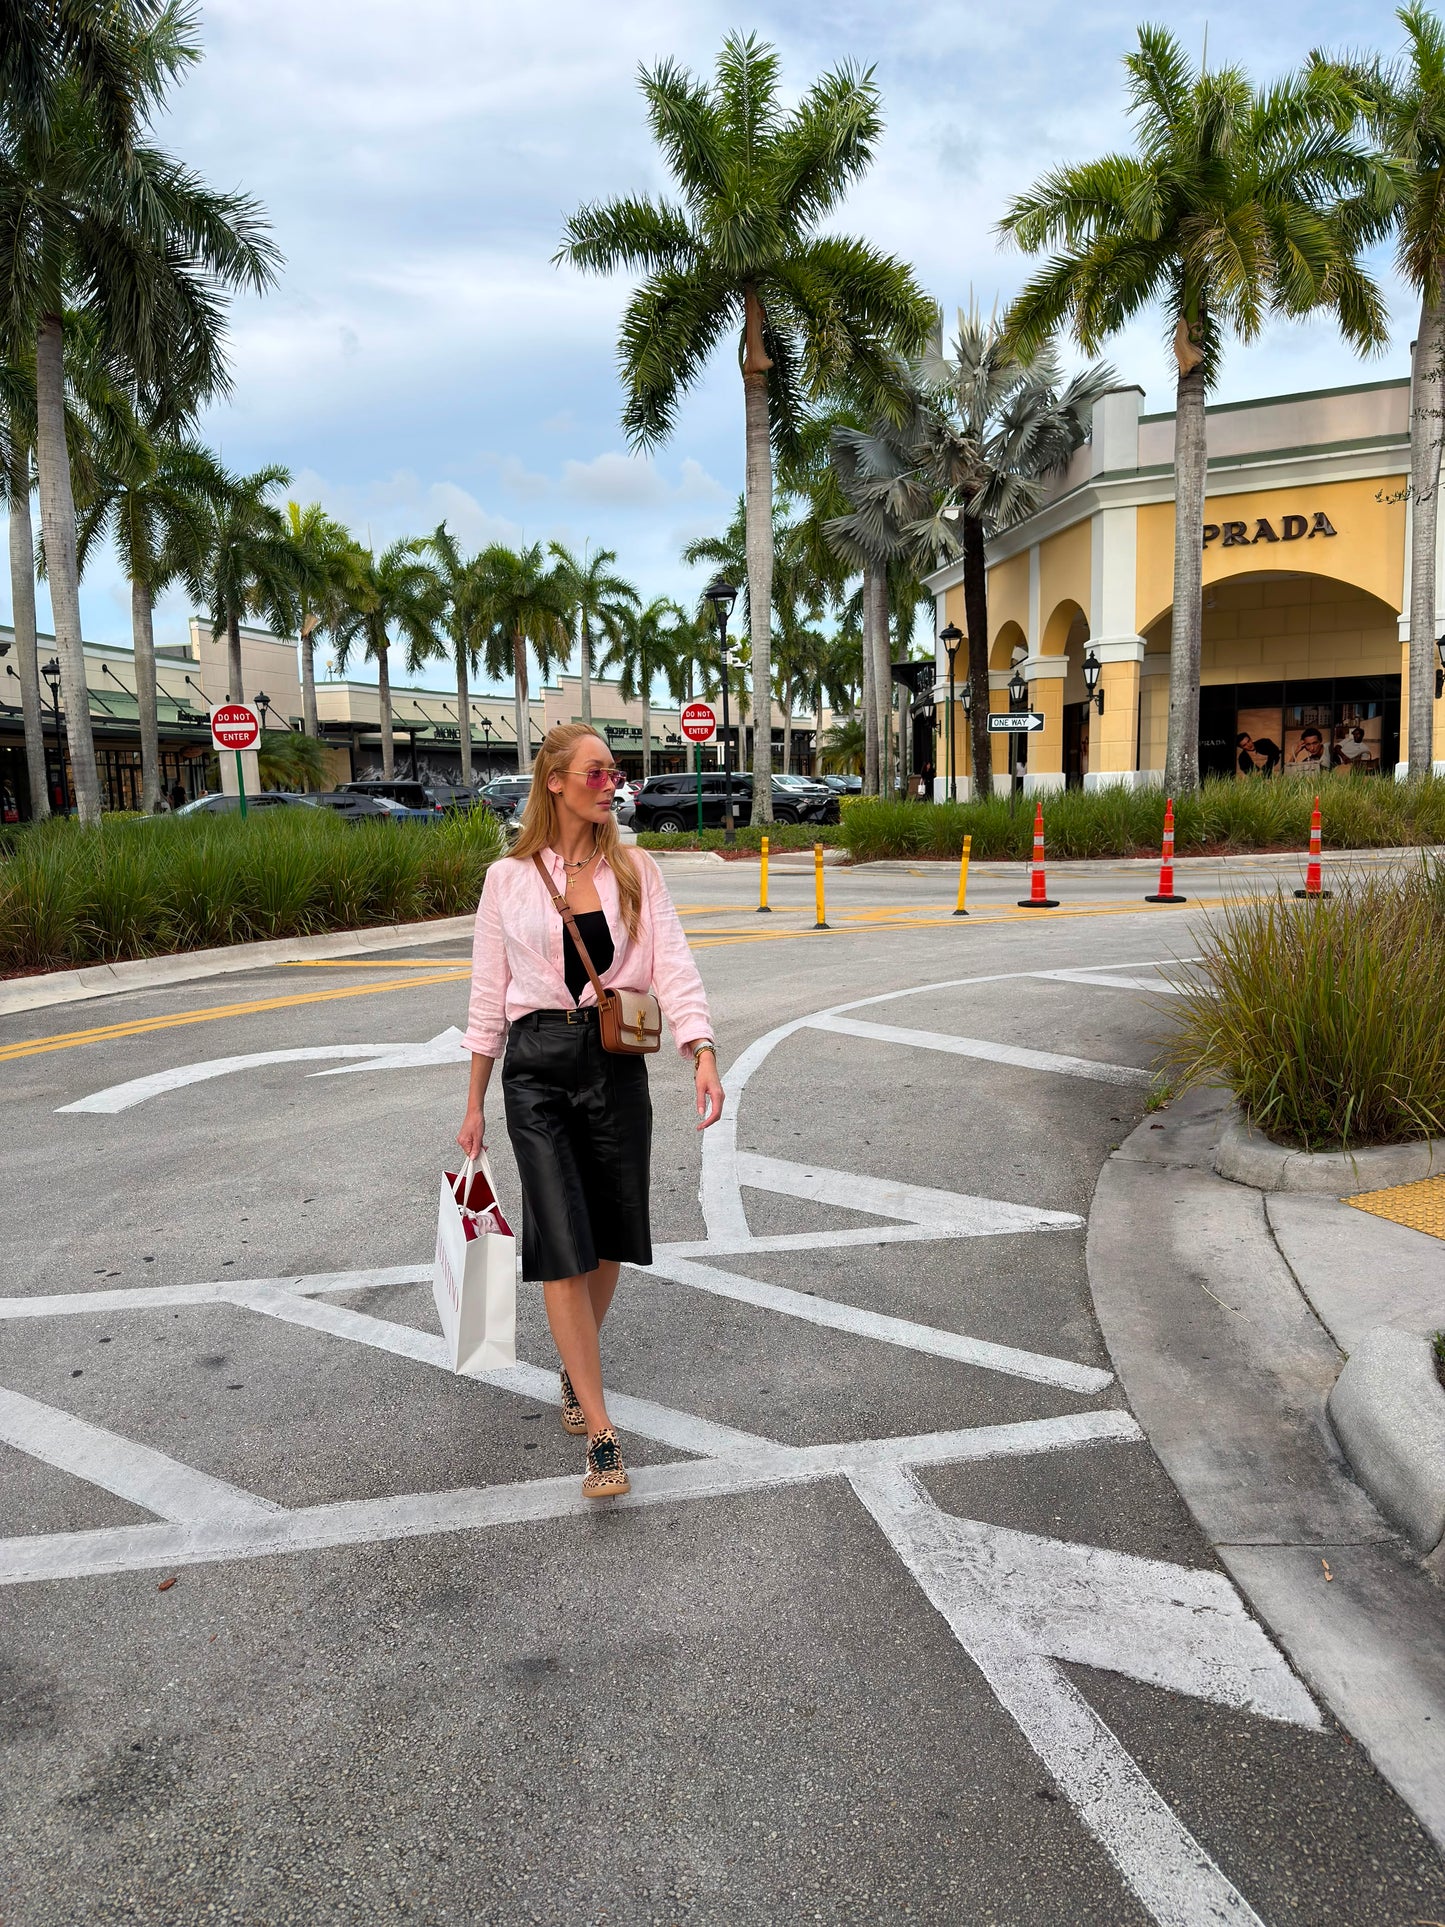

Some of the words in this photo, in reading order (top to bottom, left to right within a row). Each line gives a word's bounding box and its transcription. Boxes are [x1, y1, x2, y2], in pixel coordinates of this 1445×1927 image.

[1203, 512, 1337, 549] PRADA
[233, 713, 251, 721] NOT
[223, 733, 250, 741] ENTER
